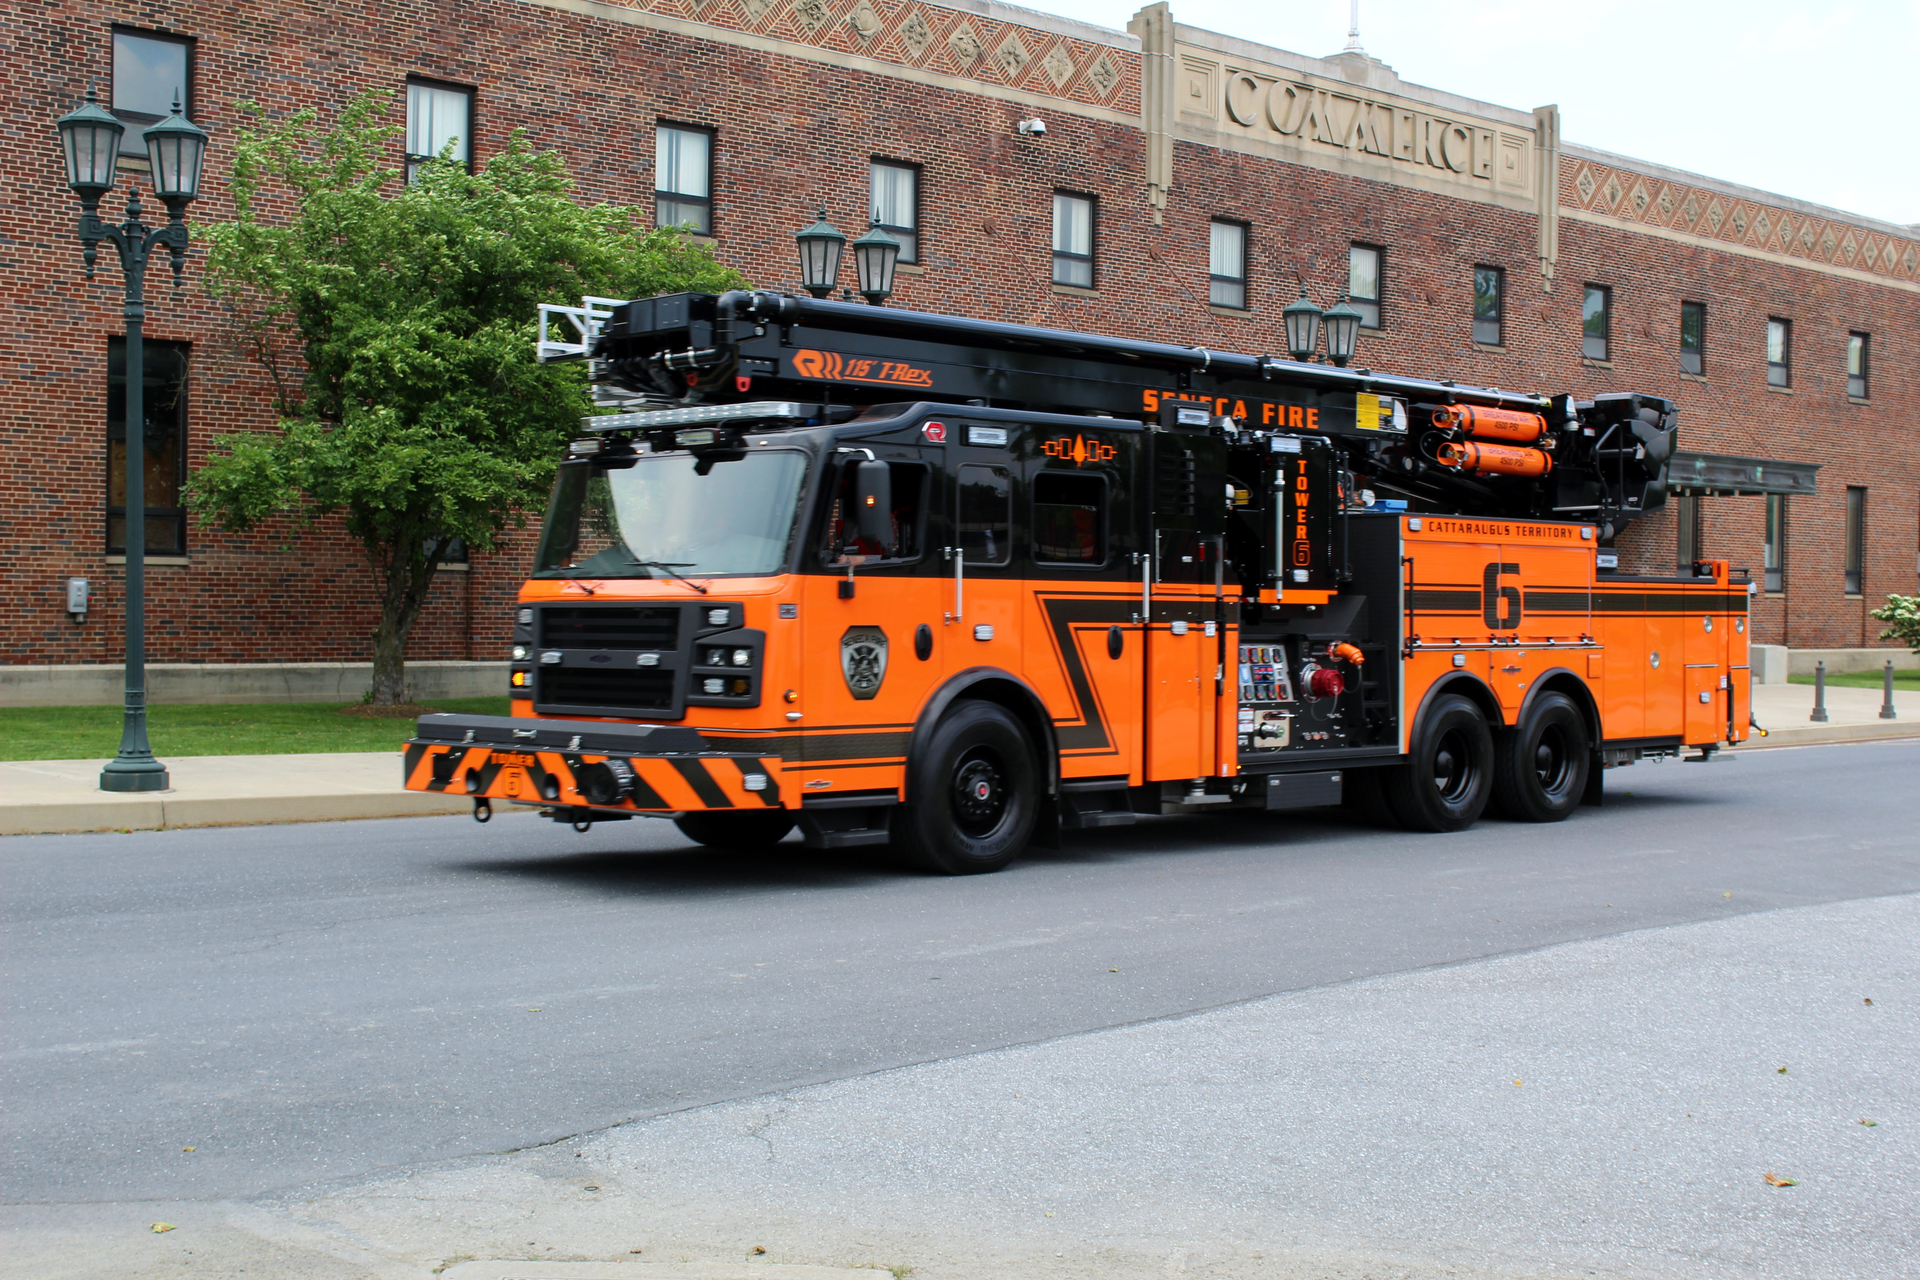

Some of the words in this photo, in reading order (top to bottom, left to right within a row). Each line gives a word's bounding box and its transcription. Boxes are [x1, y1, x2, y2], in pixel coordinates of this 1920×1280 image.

[1226, 71, 1494, 180] COMMERCE
[878, 361, 933, 387] T-Rex
[1143, 389, 1249, 421] SCA
[1262, 402, 1320, 430] FIRE
[1494, 420, 1509, 430] 4500
[1509, 422, 1520, 432] PSI
[1500, 456, 1514, 466] 4500
[1514, 458, 1525, 468] PSI
[1294, 460, 1310, 539] TOWER
[1428, 520, 1511, 536] CATTARAUGUS
[1515, 525, 1574, 539] TERRITORY
[1292, 540, 1311, 567] 6
[1483, 562, 1521, 630] 6
[490, 752, 536, 768] TOWER
[502, 764, 524, 799] 6
